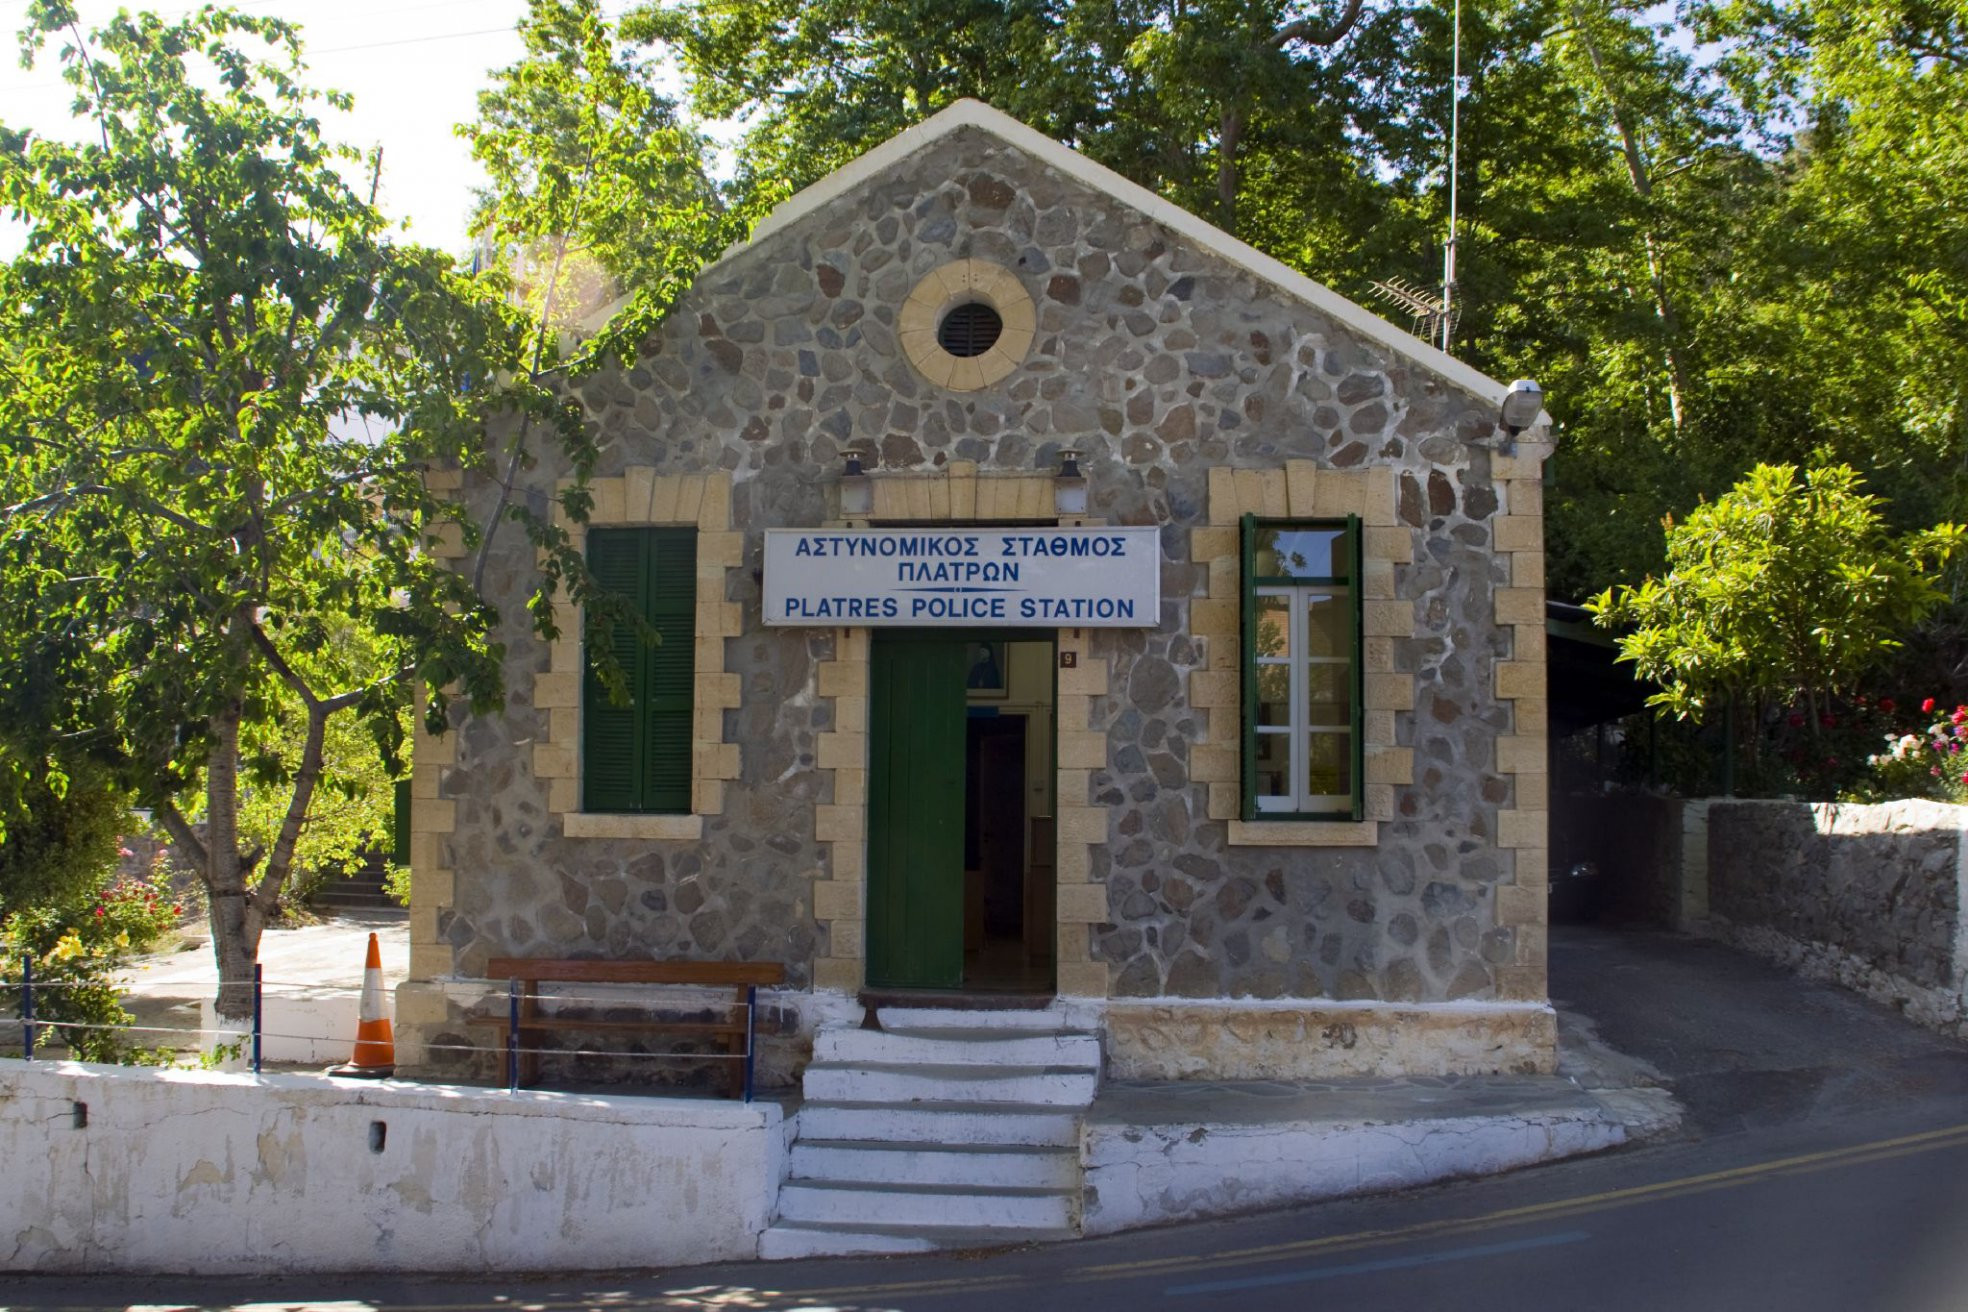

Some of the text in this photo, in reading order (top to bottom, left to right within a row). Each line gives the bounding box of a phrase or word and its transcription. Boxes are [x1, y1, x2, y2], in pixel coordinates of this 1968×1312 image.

[795, 536, 1127, 557] ΑΣΤΥΝΟΜΙΚΟΣ ΣΤΑΘΜΟΣ
[898, 561, 1020, 582] ΠΛΑΤΡΩΝ
[785, 597, 1134, 619] PLATRES POLICE STATION
[1064, 652, 1073, 666] 9
